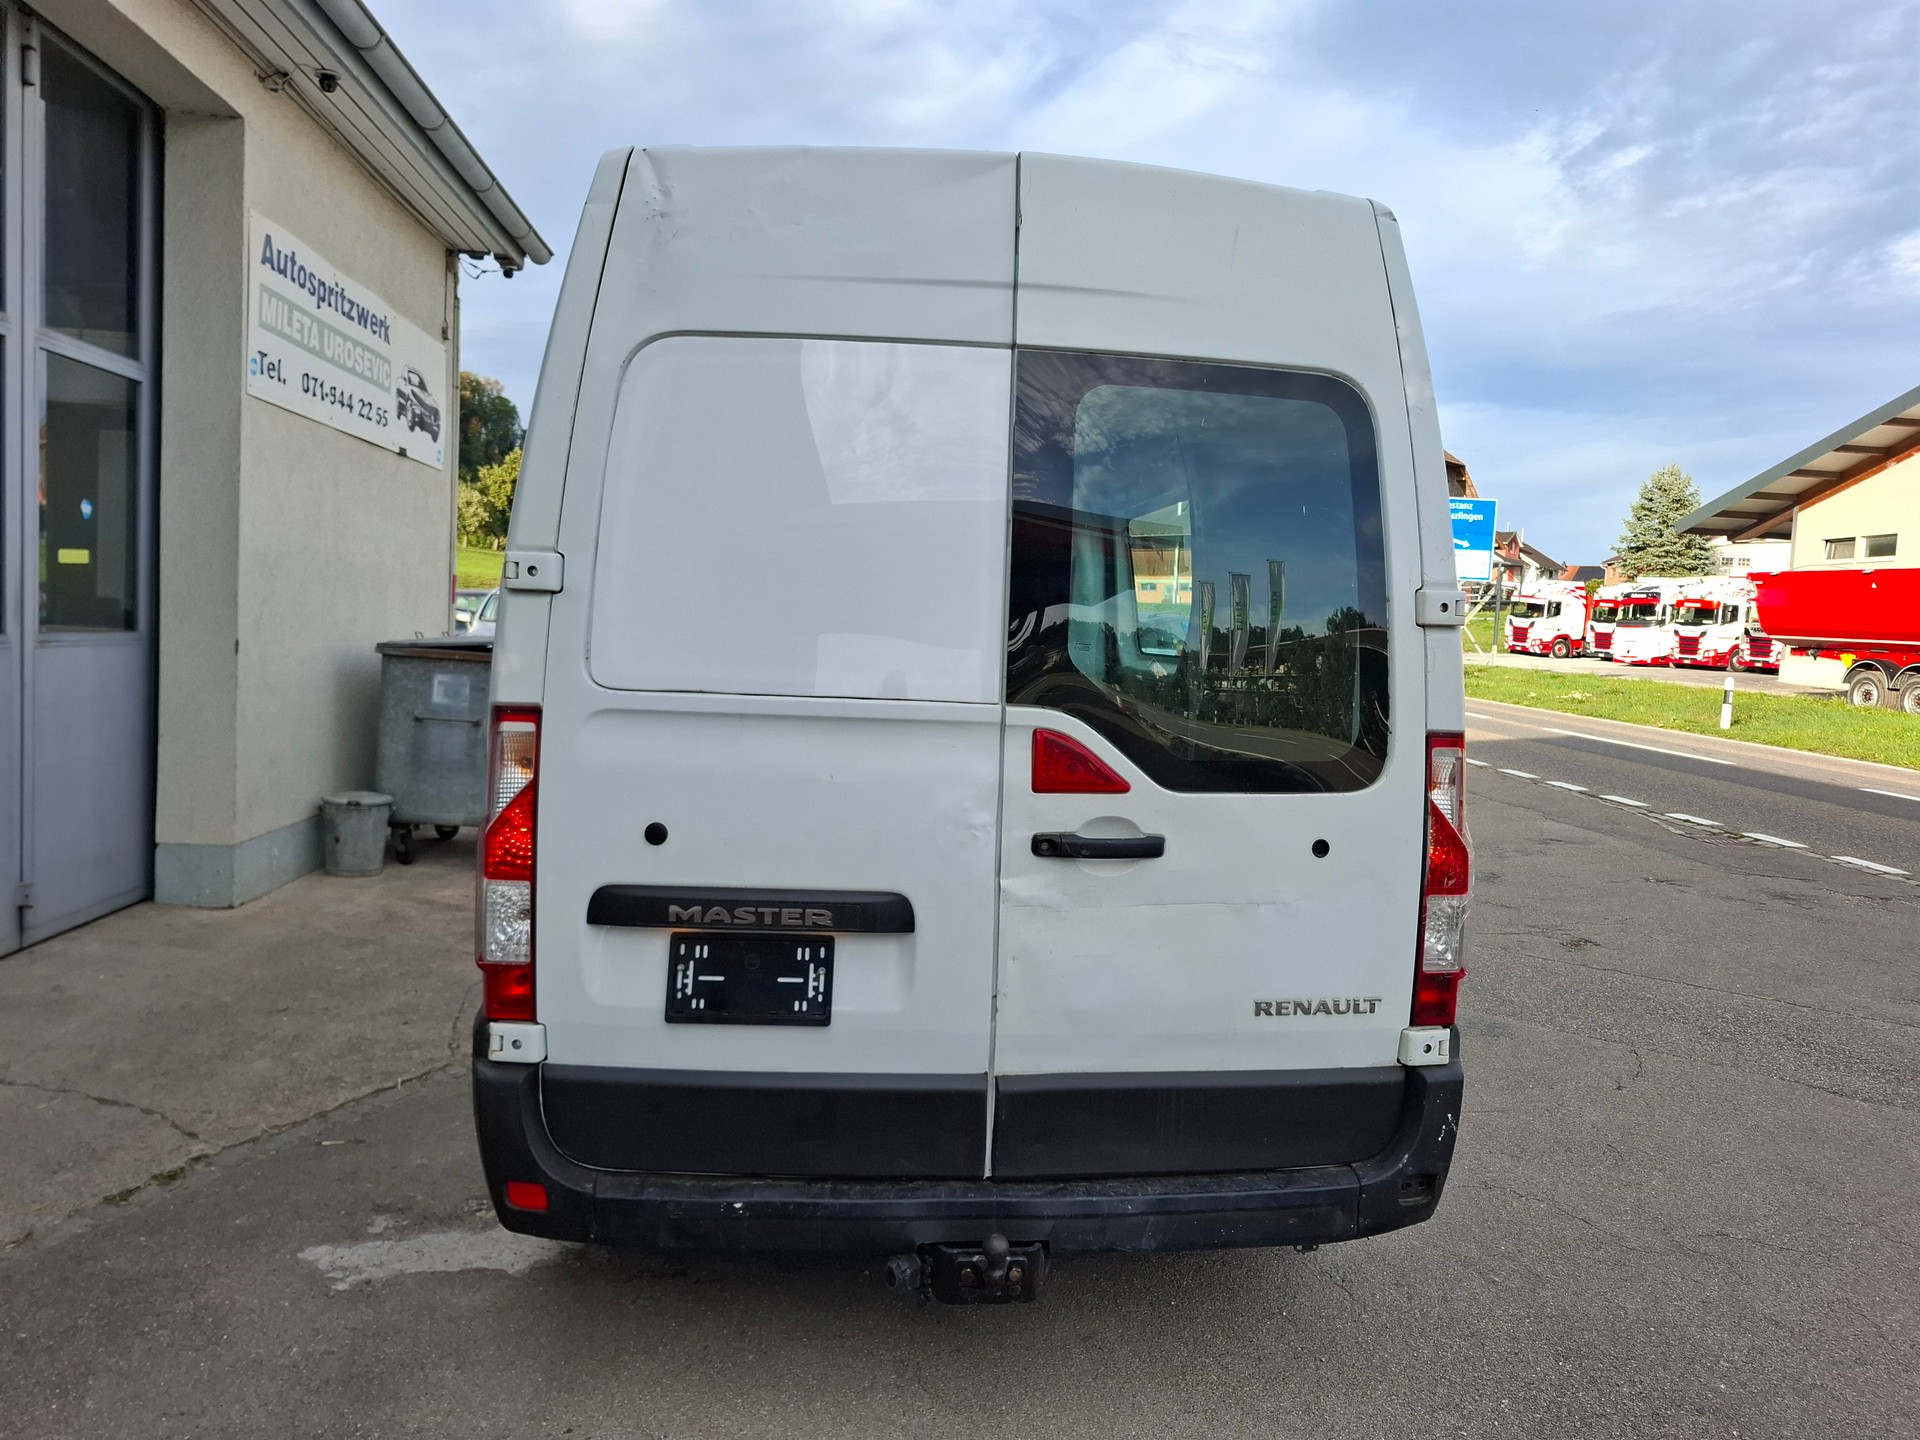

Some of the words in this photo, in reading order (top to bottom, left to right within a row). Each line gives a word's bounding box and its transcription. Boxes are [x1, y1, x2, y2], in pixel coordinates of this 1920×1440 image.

[260, 233, 391, 346] Autospritzwerk
[261, 291, 320, 351] MILETA
[324, 328, 391, 389] UROSEVIC
[257, 350, 287, 385] Tel.
[358, 398, 373, 421] 22
[375, 406, 389, 428] 55
[1234, 600, 1243, 631] FELIX
[668, 904, 834, 927] MASTER
[1254, 997, 1382, 1016] RENAULT
